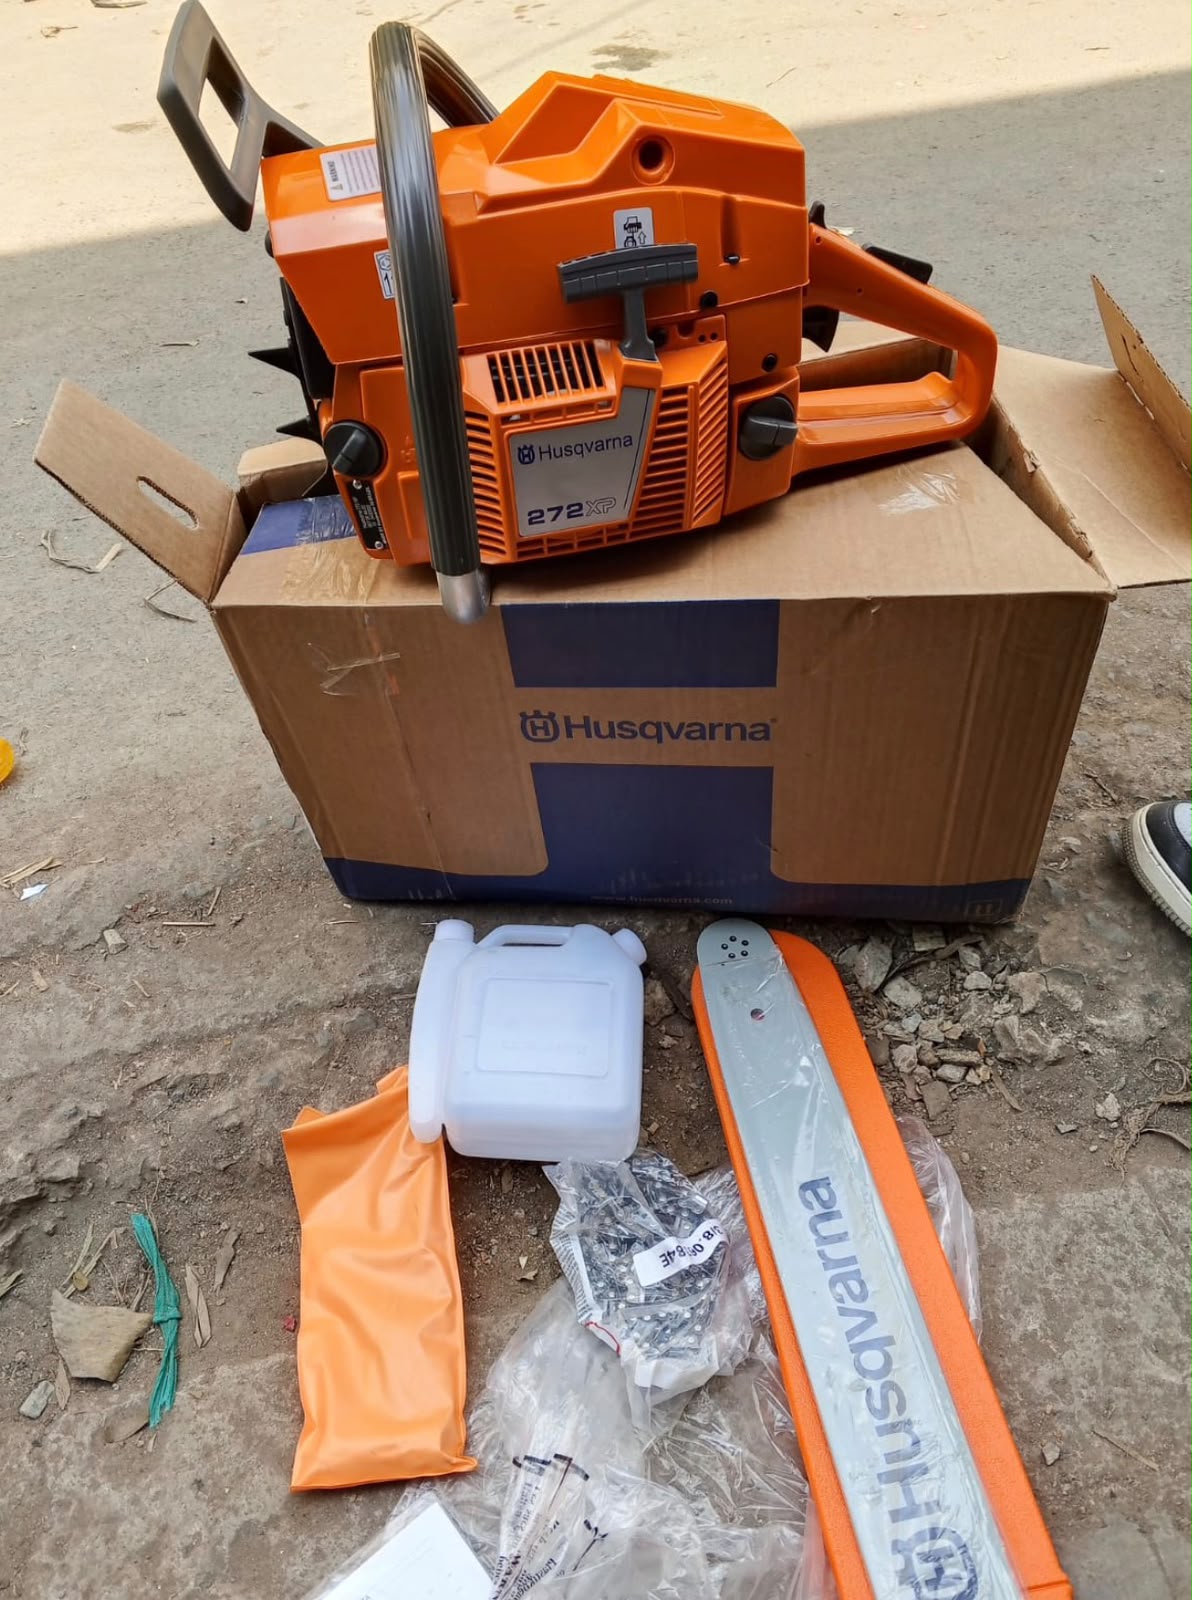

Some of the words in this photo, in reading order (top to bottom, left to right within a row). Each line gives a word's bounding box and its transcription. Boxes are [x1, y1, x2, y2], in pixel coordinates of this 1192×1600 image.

[538, 434, 633, 461] Husqvarna
[527, 497, 617, 526] 272XP
[563, 715, 771, 744] Husqvarna
[798, 1175, 941, 1524] Husqvarna
